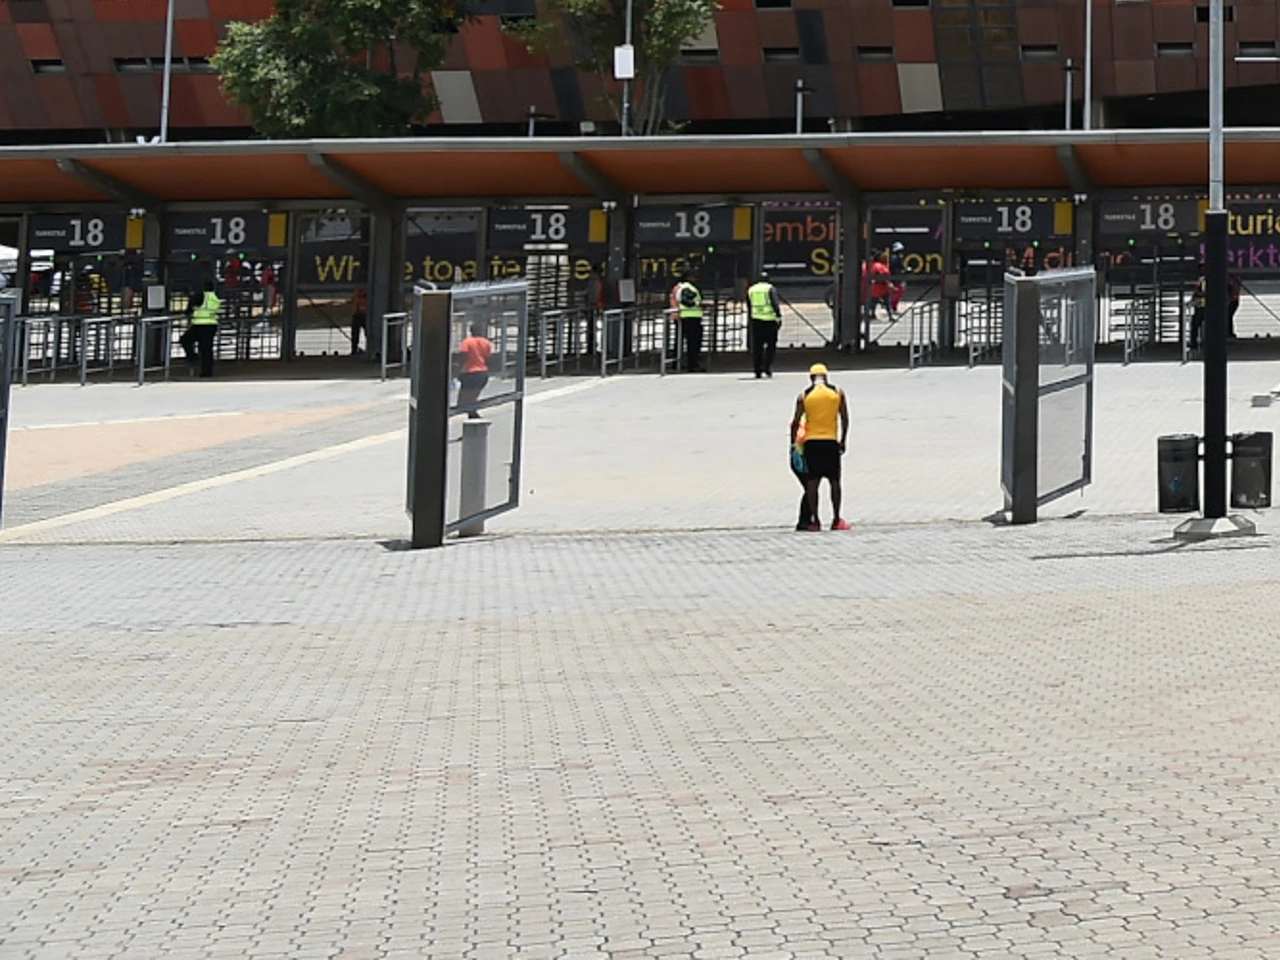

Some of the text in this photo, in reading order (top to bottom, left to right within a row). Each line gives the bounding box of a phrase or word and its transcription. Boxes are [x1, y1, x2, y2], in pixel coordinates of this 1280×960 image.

[530, 213, 566, 240] 18
[674, 211, 711, 238] 18
[996, 205, 1033, 232] 18
[1139, 203, 1175, 230] 18
[68, 219, 105, 247] 18
[210, 217, 246, 245] 18
[422, 254, 455, 282] to
